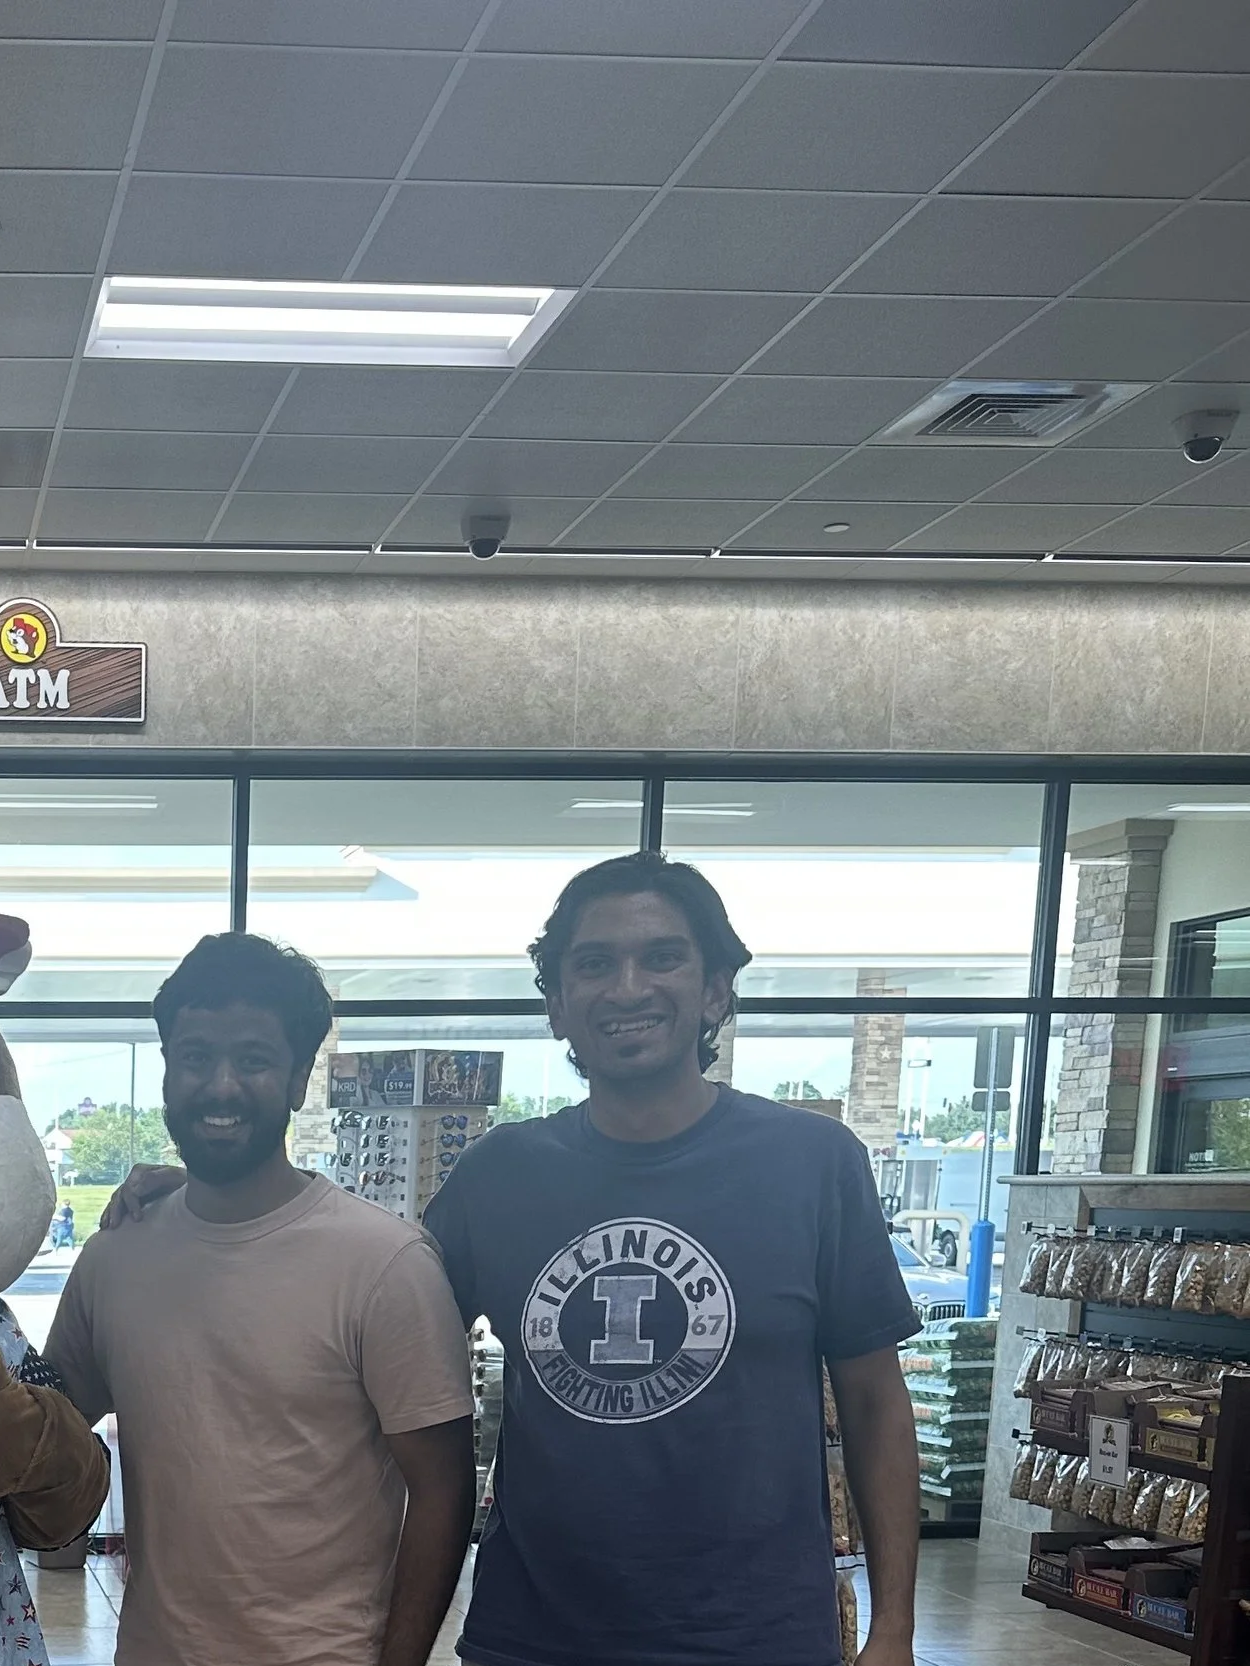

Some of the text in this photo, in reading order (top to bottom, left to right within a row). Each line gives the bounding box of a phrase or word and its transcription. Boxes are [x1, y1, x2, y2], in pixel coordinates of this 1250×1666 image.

[537, 1229, 718, 1307] ILLINOIS
[528, 1315, 553, 1338] 18
[691, 1314, 725, 1336] 67
[540, 1353, 707, 1413] FIGHTING ILLINI
